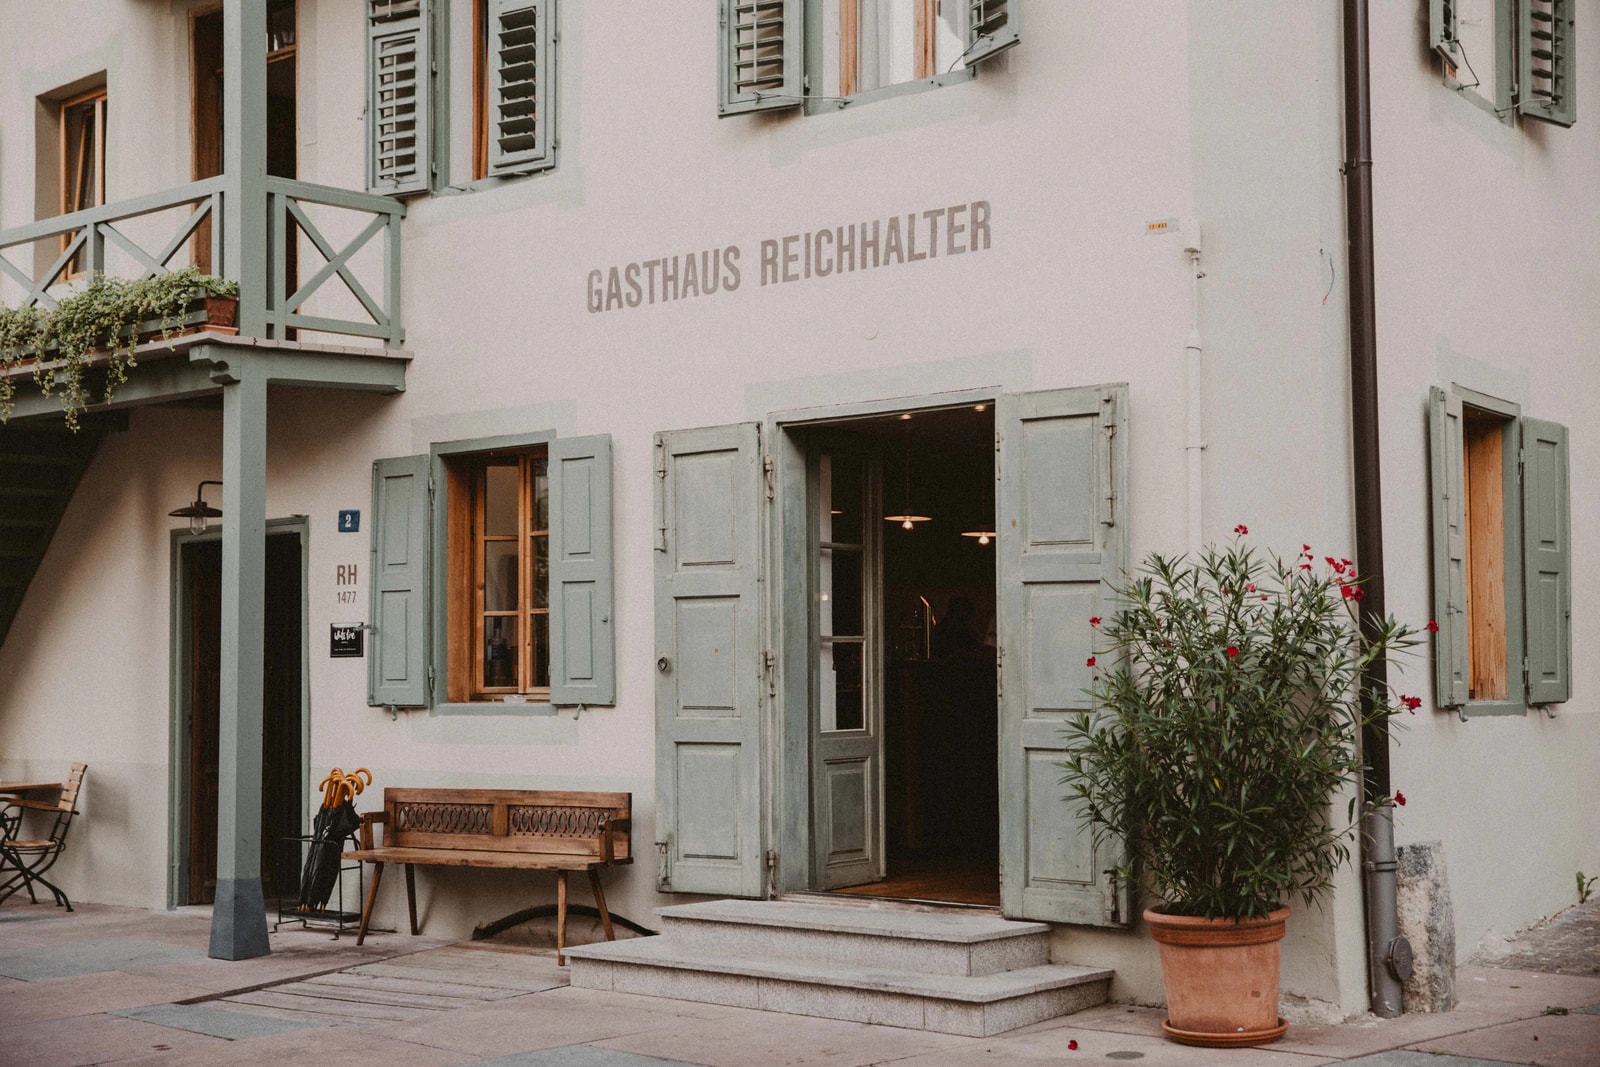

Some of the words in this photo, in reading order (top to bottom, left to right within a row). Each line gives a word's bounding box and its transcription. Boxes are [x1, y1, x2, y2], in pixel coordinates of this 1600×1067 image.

[587, 245, 741, 313] GASTHAUS
[761, 200, 991, 286] REICHHALTER
[344, 513, 352, 528] 2
[337, 564, 357, 586] RH
[337, 591, 357, 604] 1477
